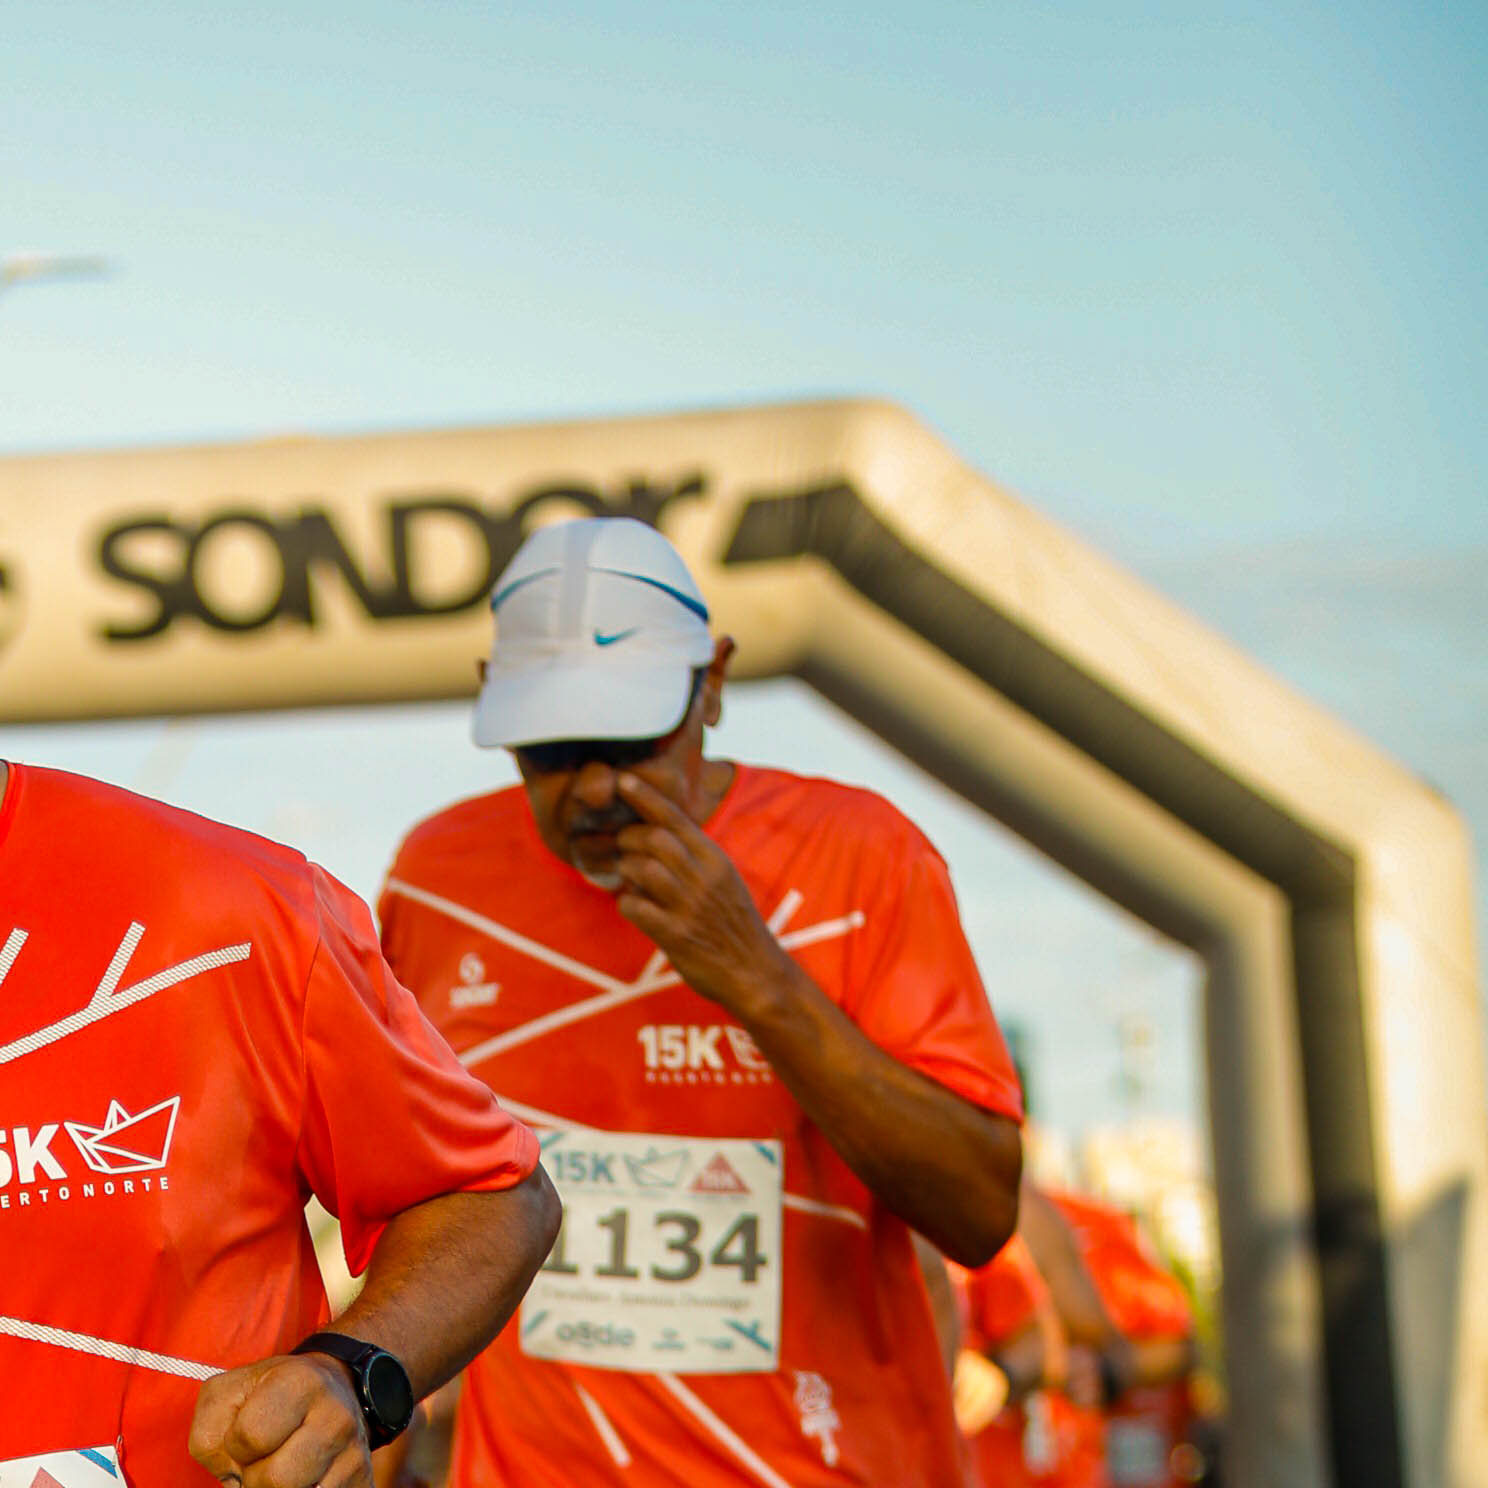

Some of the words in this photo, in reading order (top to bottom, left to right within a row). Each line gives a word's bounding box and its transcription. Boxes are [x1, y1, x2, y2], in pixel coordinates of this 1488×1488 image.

[638, 1024, 724, 1070] 15K
[552, 1150, 615, 1183] 15K
[83, 1177, 169, 1197] NORTE
